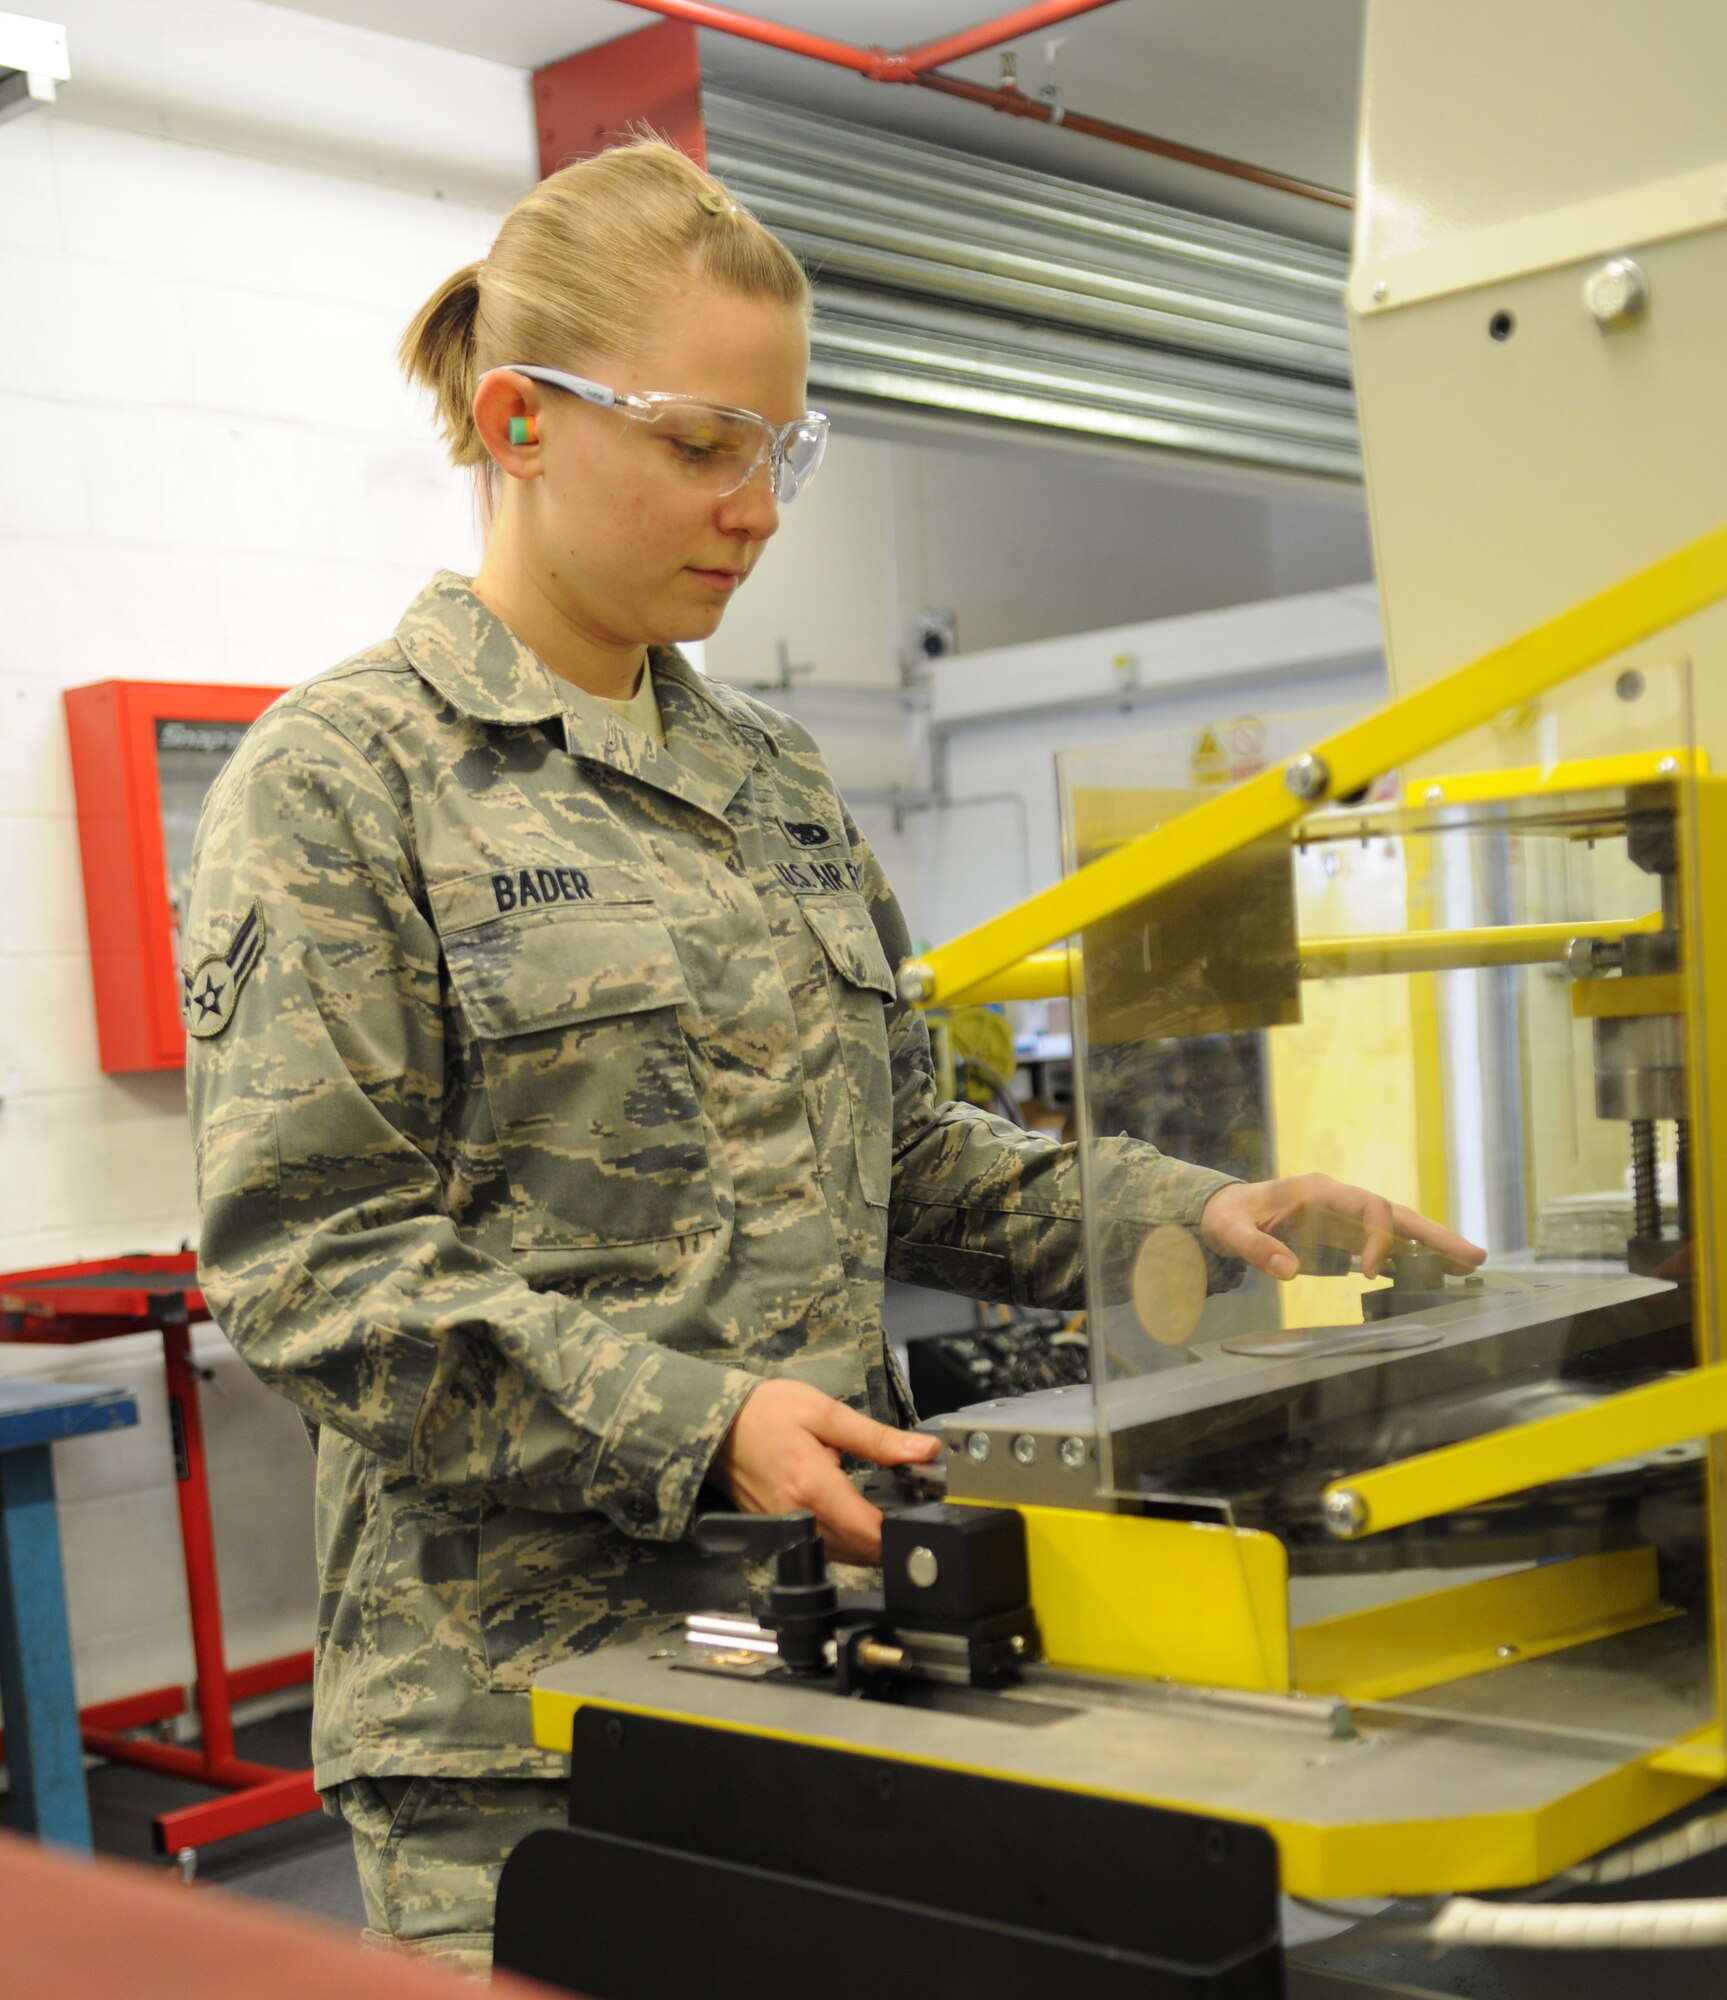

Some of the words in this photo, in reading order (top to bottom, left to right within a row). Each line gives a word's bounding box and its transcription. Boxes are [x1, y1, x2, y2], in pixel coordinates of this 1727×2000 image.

[491, 868, 594, 912] BADER
[774, 862, 817, 888] U.S.
[808, 862, 850, 892] AIR
[844, 861, 863, 892] F
